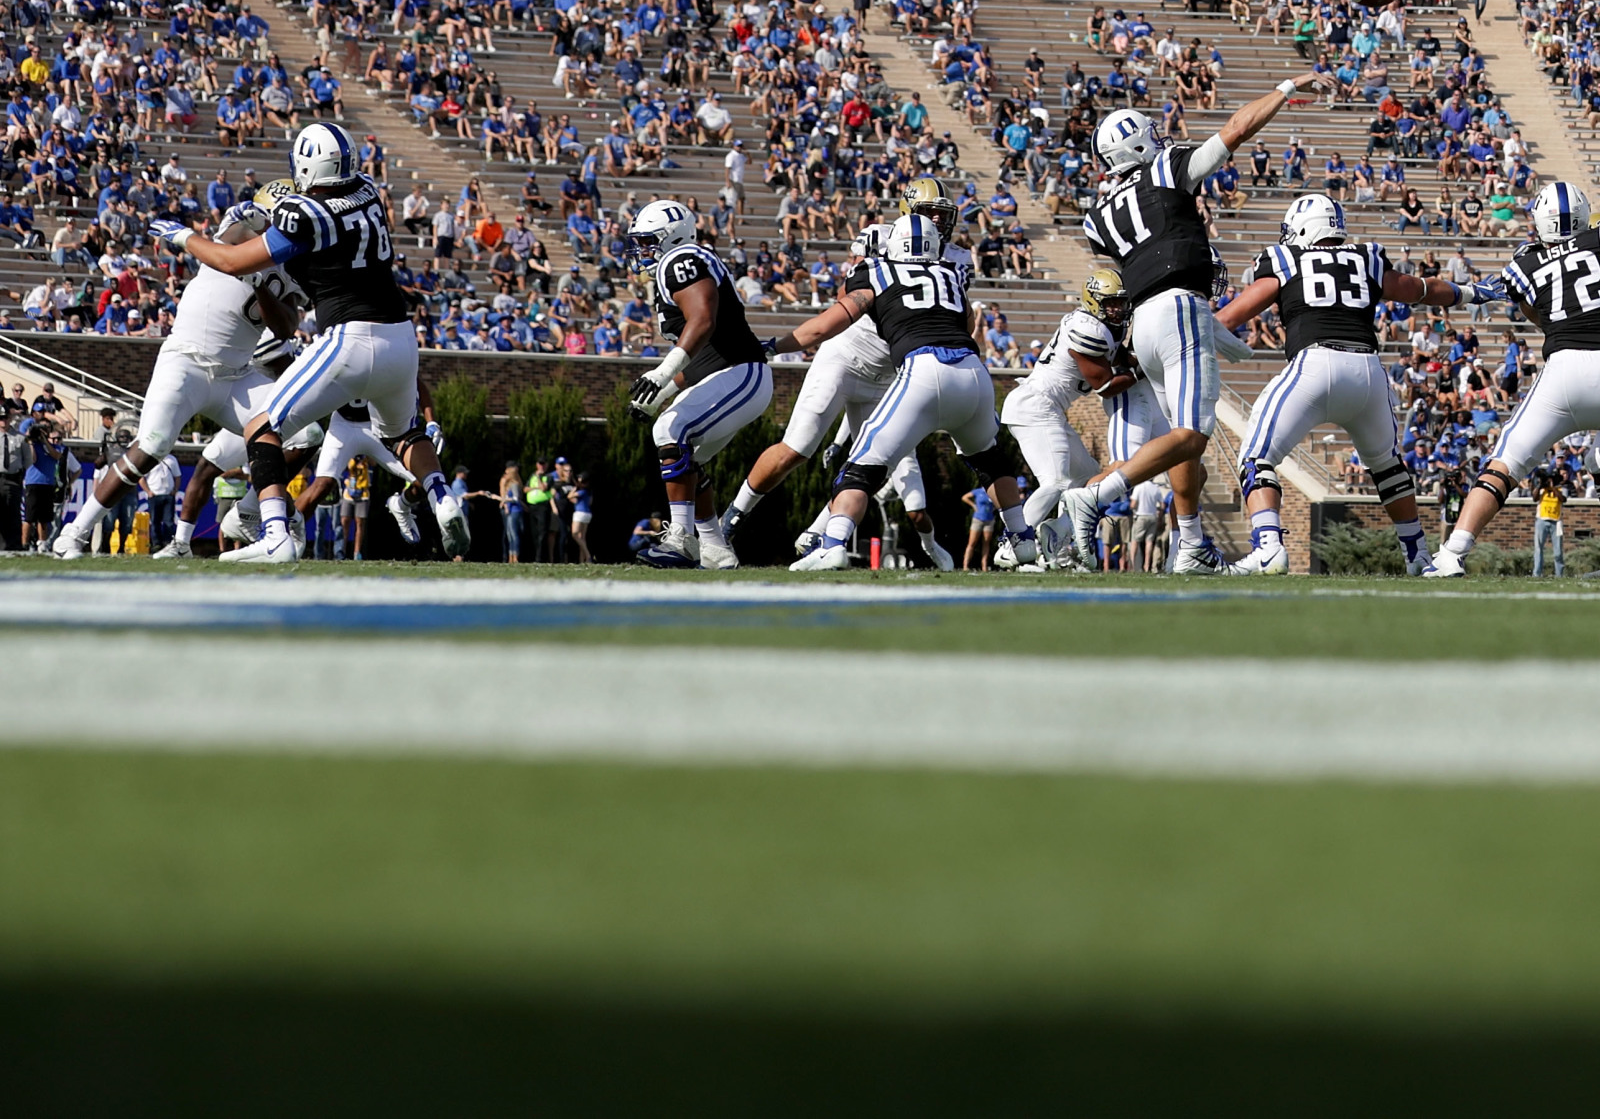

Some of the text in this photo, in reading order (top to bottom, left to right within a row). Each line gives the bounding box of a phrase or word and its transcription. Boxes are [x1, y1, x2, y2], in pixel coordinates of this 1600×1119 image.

[266, 181, 291, 197] Pitt
[1106, 169, 1142, 200] JONES
[278, 207, 299, 233] 76
[1100, 185, 1152, 257] 17
[341, 203, 391, 269] 76
[903, 241, 910, 253] 5
[1536, 238, 1579, 265] LISLE
[673, 258, 698, 284] 65
[1300, 251, 1371, 309] 63
[893, 263, 964, 314] 50
